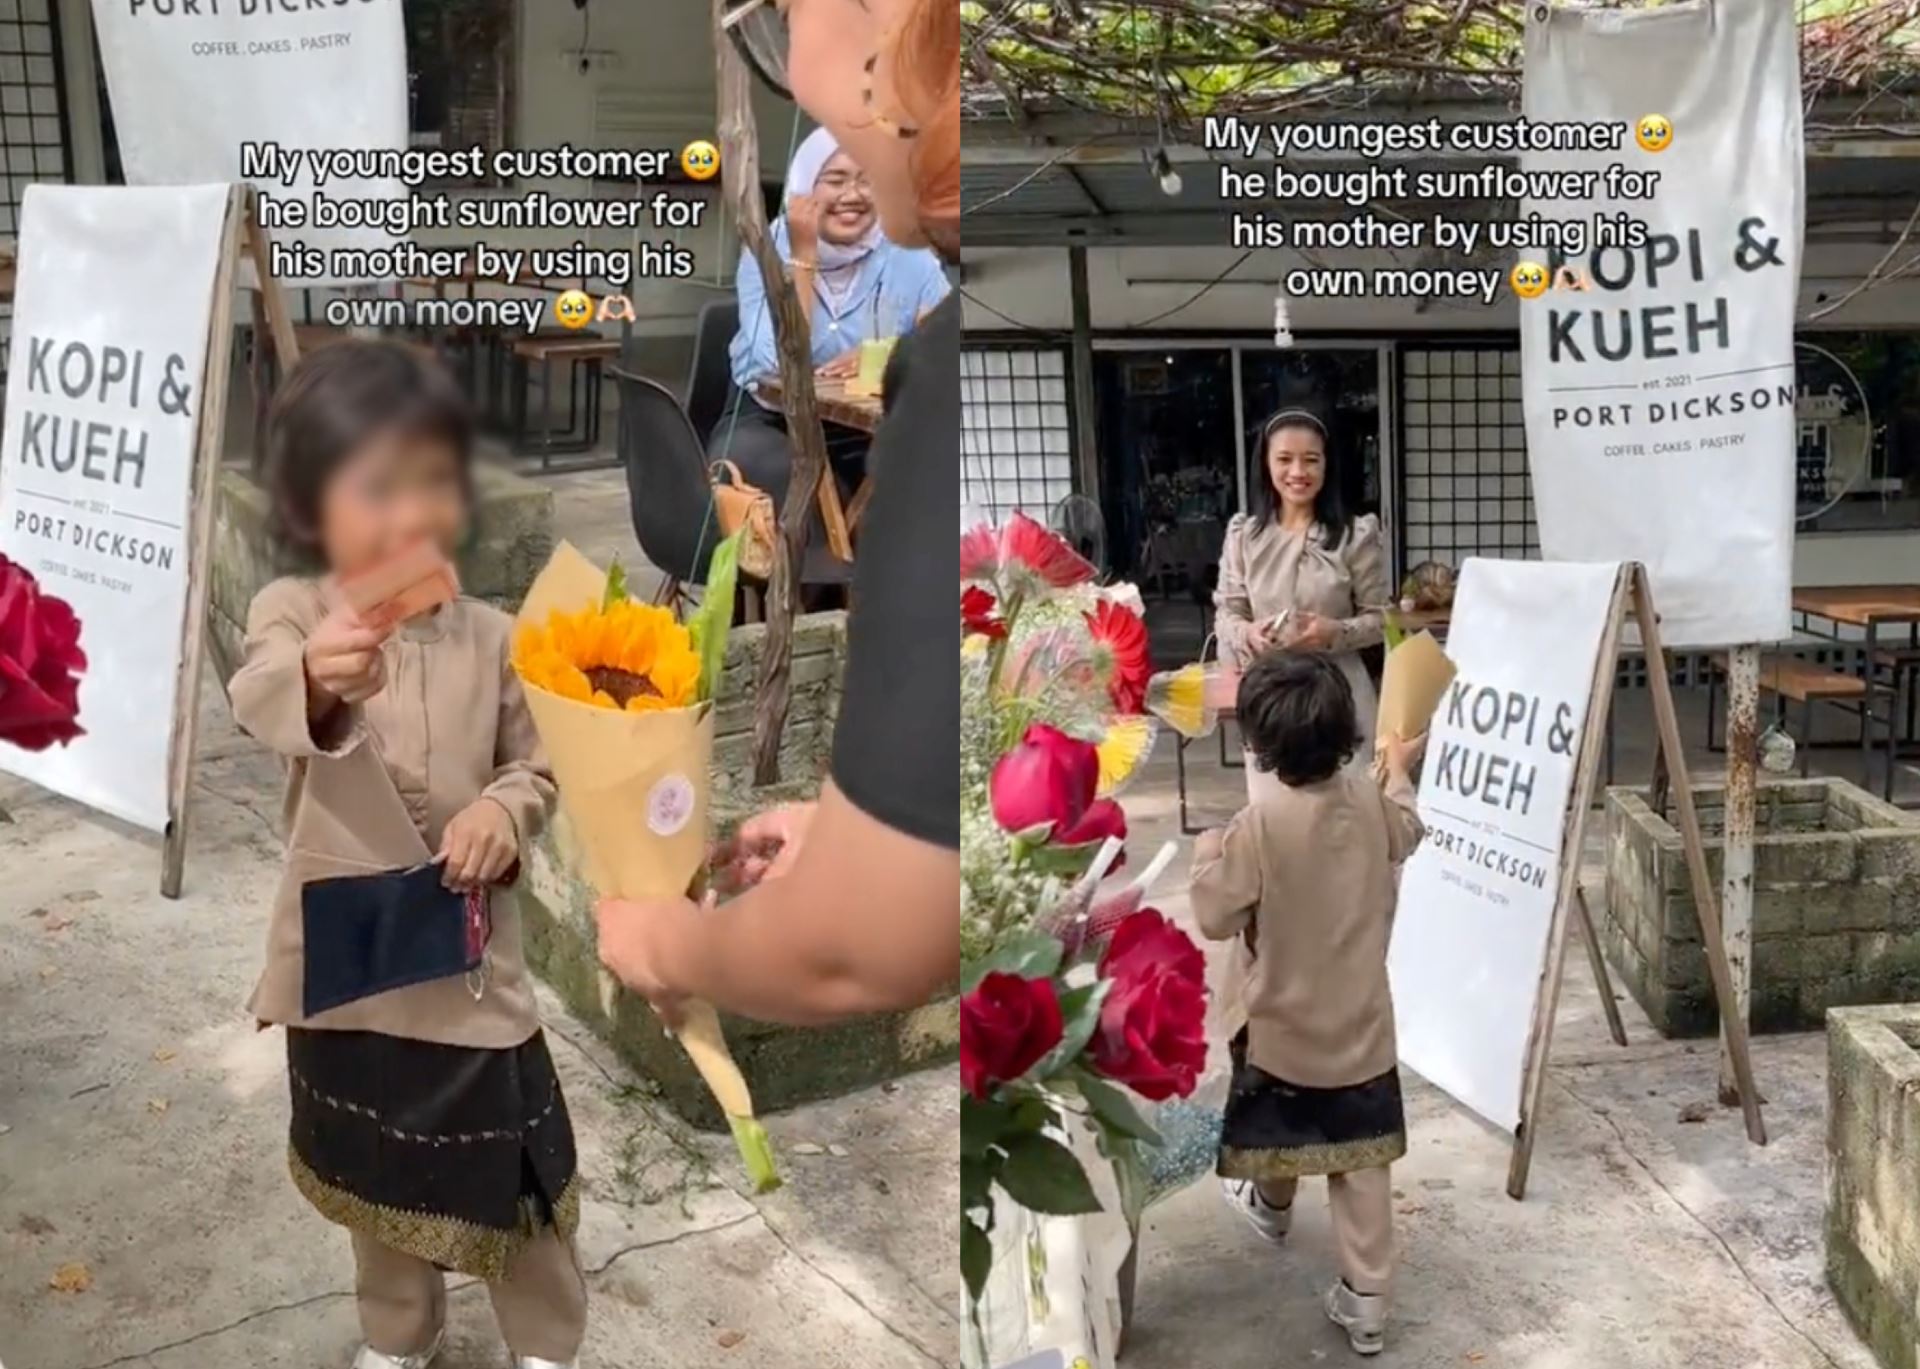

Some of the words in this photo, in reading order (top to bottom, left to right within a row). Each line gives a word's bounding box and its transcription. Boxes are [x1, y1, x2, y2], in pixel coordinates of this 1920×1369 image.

[191, 41, 240, 56] COFFEE
[249, 39, 292, 55] CAKES
[299, 32, 352, 51] PASTRY
[1734, 217, 1786, 272] &
[1548, 297, 1730, 363] KUEH
[27, 336, 144, 409] KOPI
[157, 352, 193, 418] &
[1553, 404, 1632, 429] PORT
[1649, 384, 1794, 423] DICKSON
[1664, 374, 1692, 388] 2021
[20, 410, 149, 489] KUEH
[1603, 445, 1646, 458] COFFEE
[1652, 440, 1692, 455] CAKES
[1700, 433, 1746, 450] PASTRY
[15, 509, 66, 541] PORT
[72, 523, 174, 571] DICKSON
[1447, 680, 1540, 747] KOPI
[1547, 701, 1575, 757] &
[1435, 741, 1537, 815] KUEH
[1425, 824, 1465, 855] PORT
[1467, 841, 1547, 889] DICKSON
